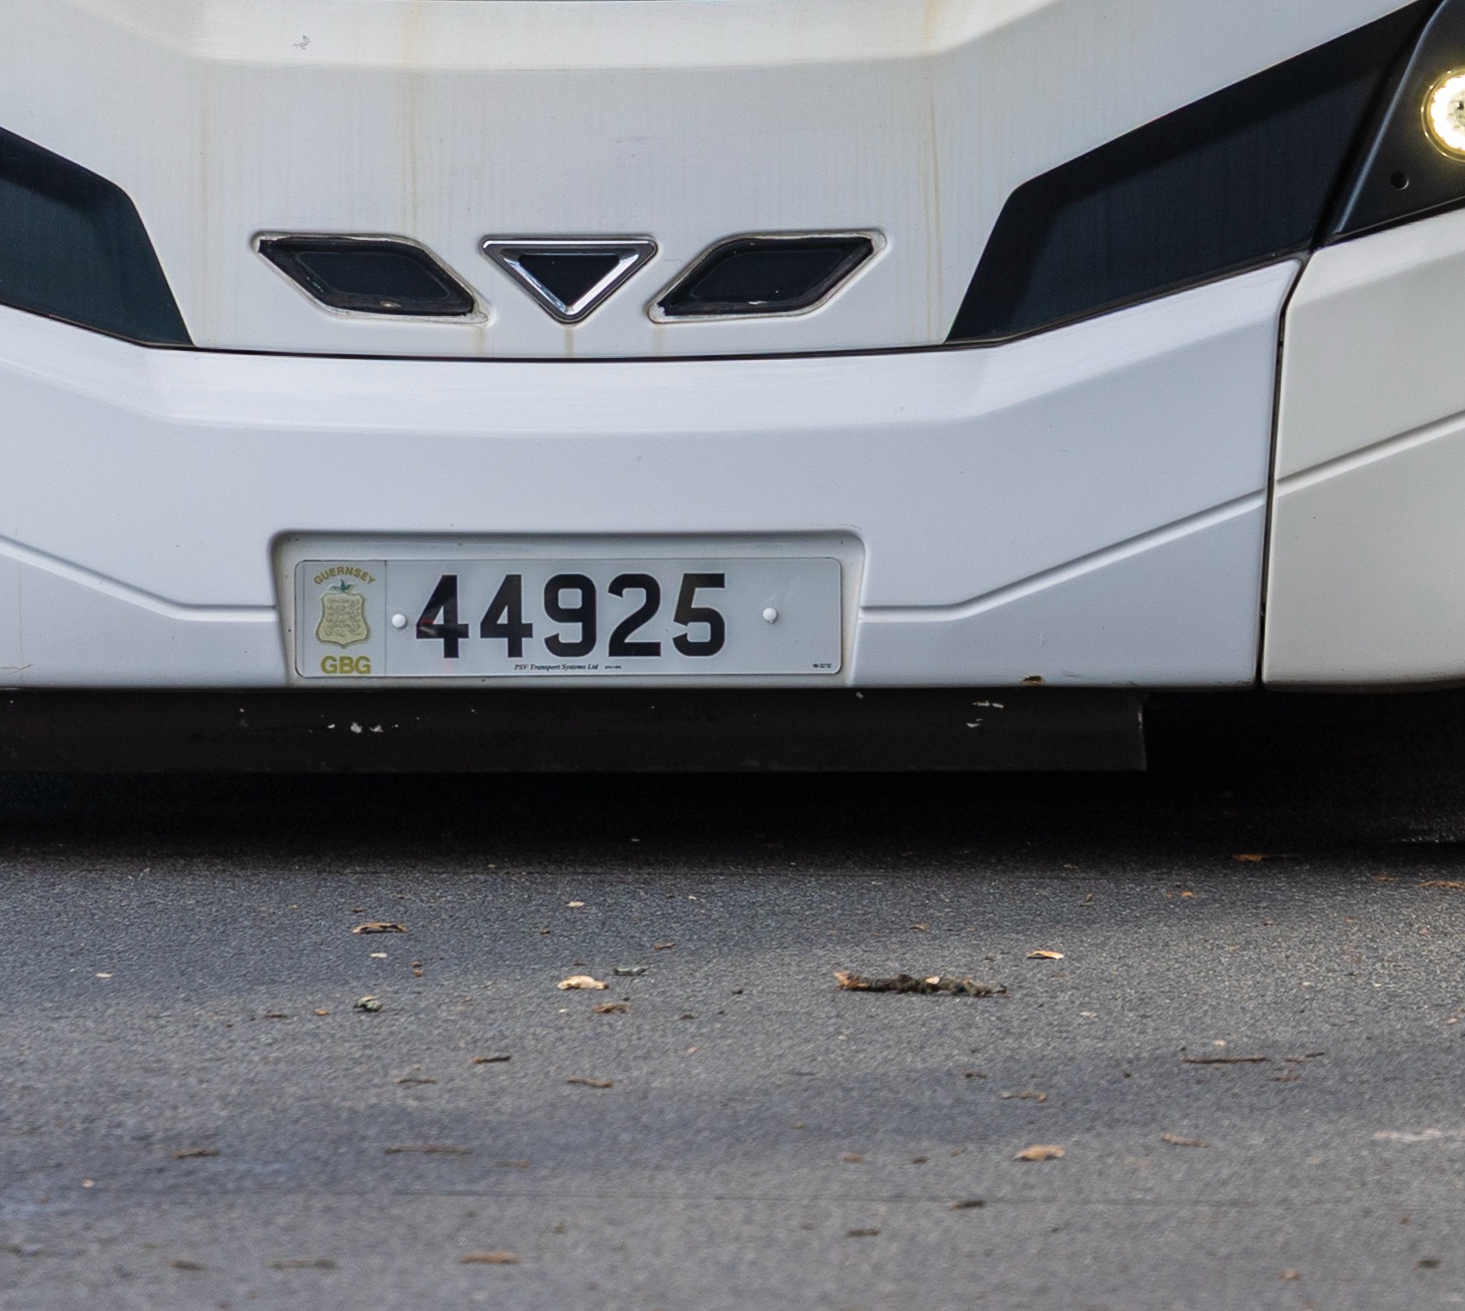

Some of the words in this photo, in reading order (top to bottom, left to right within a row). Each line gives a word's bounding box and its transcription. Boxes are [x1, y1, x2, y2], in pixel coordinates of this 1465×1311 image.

[313, 565, 376, 585] GUERNSEY
[415, 572, 726, 658] 44925
[320, 655, 372, 675] GBG
[514, 663, 528, 671] PSV
[530, 663, 560, 672] Transport
[561, 663, 586, 672] Systems
[587, 663, 599, 671] Ltd
